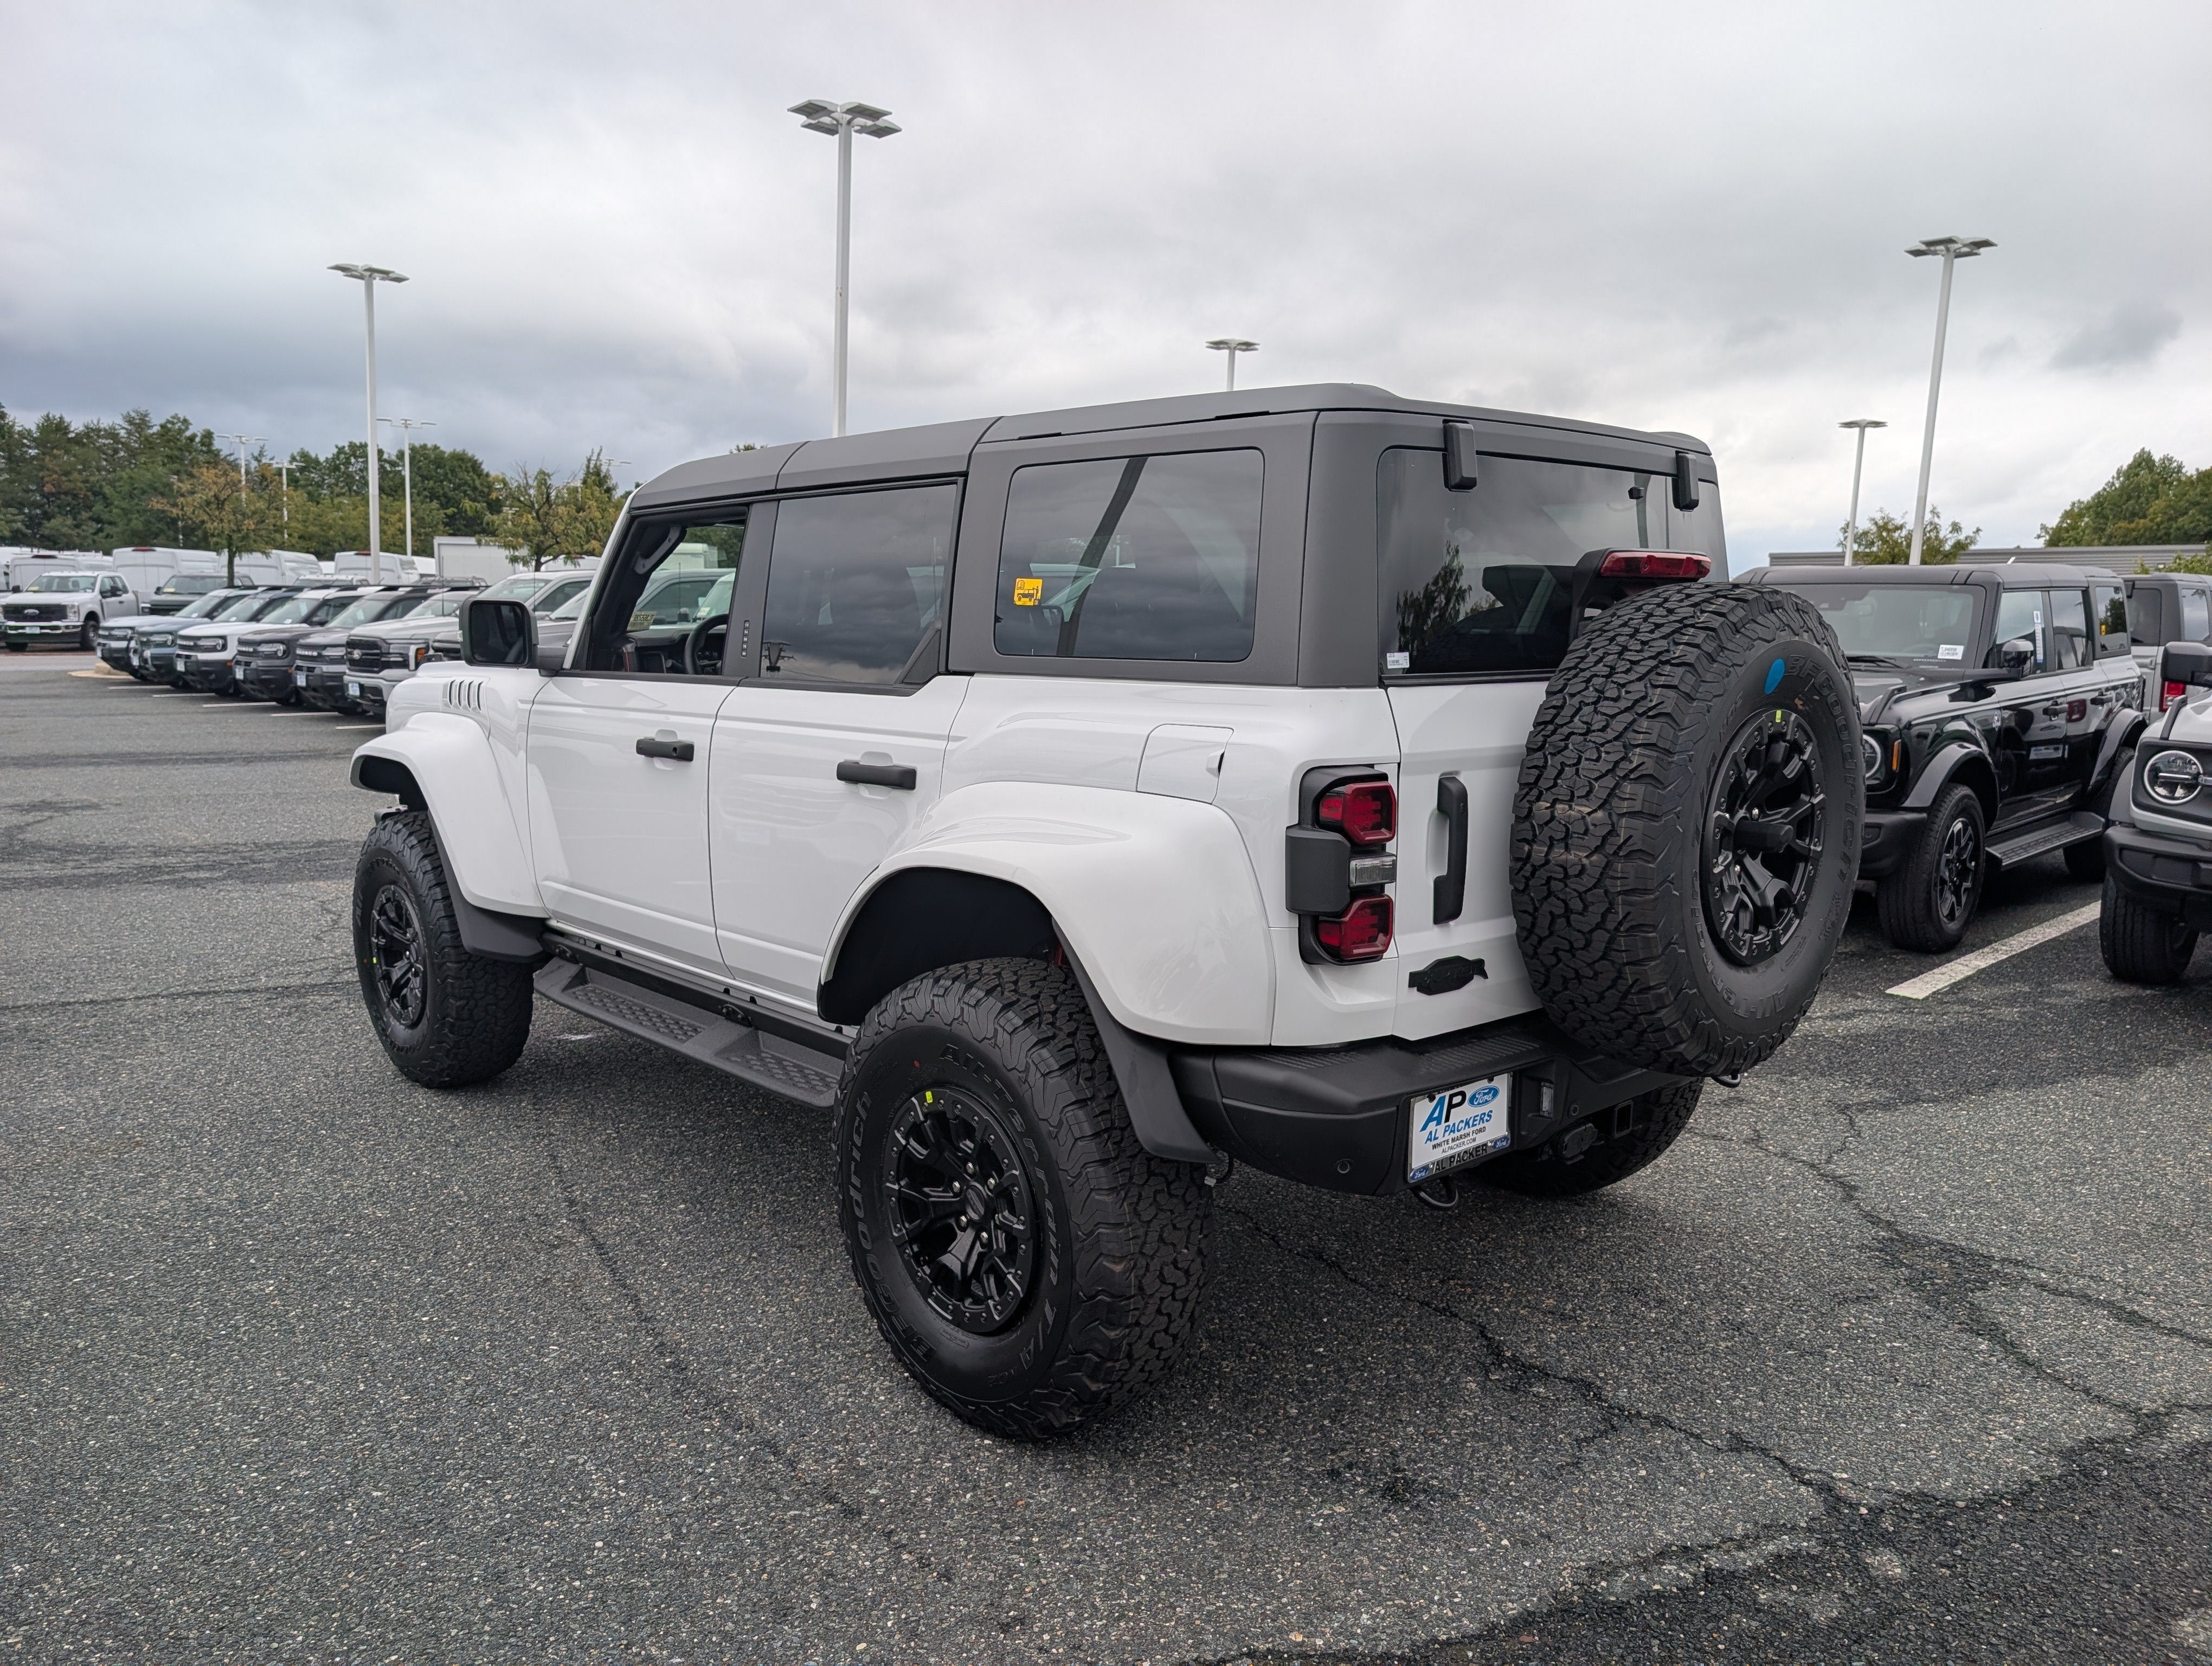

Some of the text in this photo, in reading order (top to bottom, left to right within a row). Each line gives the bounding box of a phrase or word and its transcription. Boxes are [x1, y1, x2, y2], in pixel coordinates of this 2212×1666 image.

[1419, 1090, 1467, 1133] AP
[1424, 1110, 1493, 1144] AL PACKERS
[1432, 1126, 1486, 1150] WHITE MARSH FORD
[1433, 1143, 1488, 1173] AL PACKER
[1441, 1137, 1476, 1154] ALPACKER.COM
[1413, 1168, 1429, 1179] Ford
